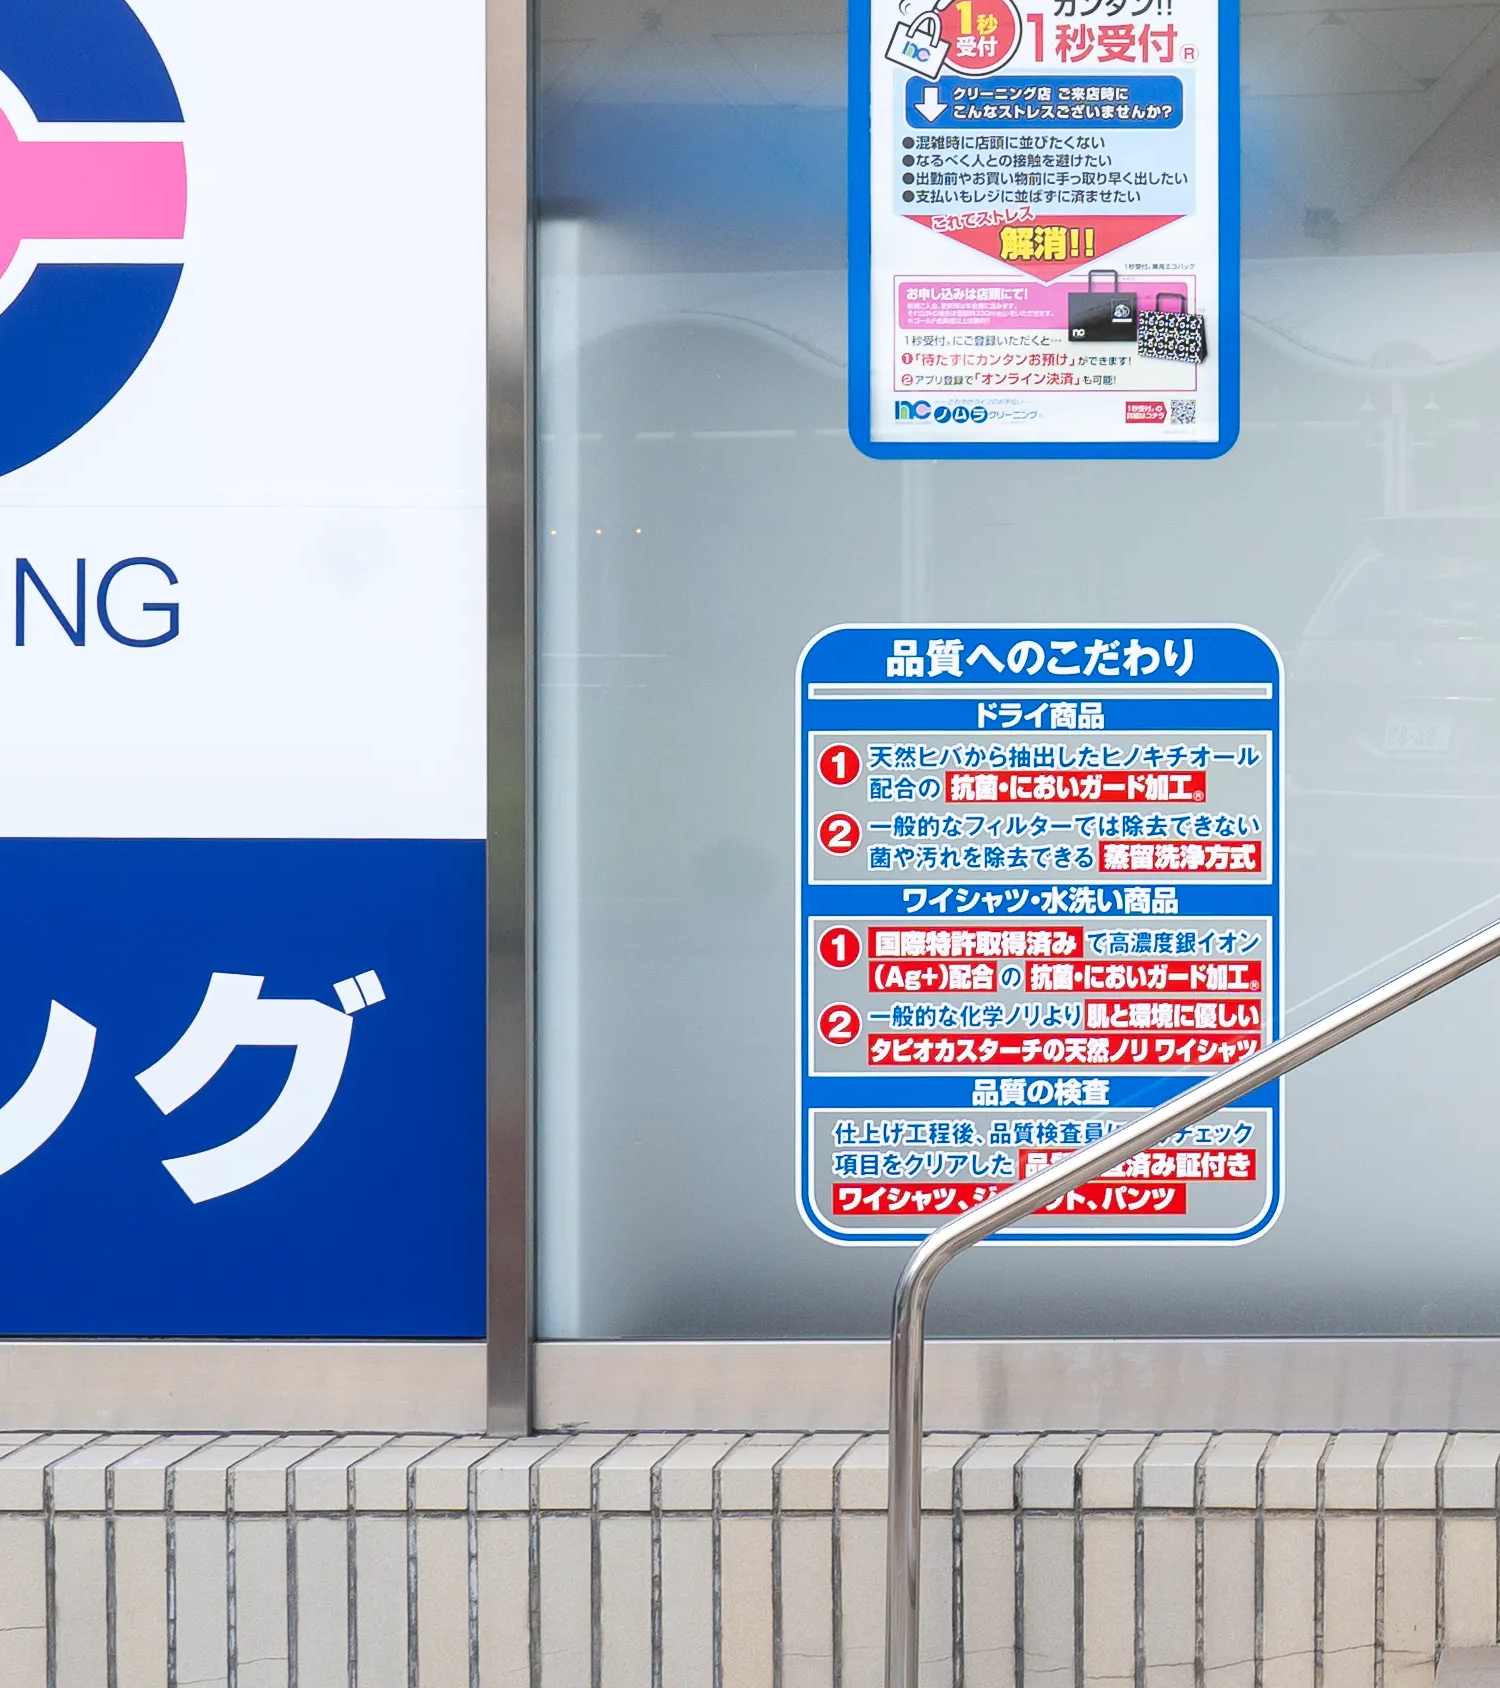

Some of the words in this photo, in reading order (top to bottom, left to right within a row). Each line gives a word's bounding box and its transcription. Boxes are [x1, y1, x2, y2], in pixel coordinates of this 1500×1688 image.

[955, 0, 999, 35] 1秒
[956, 36, 999, 58] 受付
[952, 86, 1053, 102] クリーニング店
[1058, 86, 1130, 102] ご来店時に
[952, 102, 1173, 120] こんなストレスございませんか?
[915, 153, 1113, 169] なるべく人との接触を避けたい
[999, 225, 1097, 261] 解消!!
[906, 287, 1029, 301] お申し込みは店頭にて!
[885, 638, 1195, 678] 品質へのこだわり
[975, 701, 1105, 730] ドライ商品
[868, 745, 1260, 769] 天然ヒバから抽出したヒノキチオール
[868, 775, 941, 801] 配合の
[868, 813, 1260, 839] 一般的なフィルターでは除去できない
[868, 845, 1094, 871] 菌や汚れを除去できる
[1103, 843, 1259, 871] 蒸留洗浄方式
[902, 887, 1179, 915] ワイシャツ・水洗い商品
[874, 929, 1077, 957] 国際特許取得済み
[1087, 931, 1260, 955] で高濃度銀イオン
[1002, 968, 1021, 988] の
[868, 1004, 1081, 1029] 一般的な化学ノリより
[1087, 1002, 1259, 1030] 肌と環境に優しい
[870, 1036, 1149, 1064] タピオカスターチの天然ノリ
[1156, 1037, 1259, 1064] ワイシャツ
[972, 1079, 1109, 1107] 品質の検査
[833, 1151, 1014, 1177] 項目をクリアした
